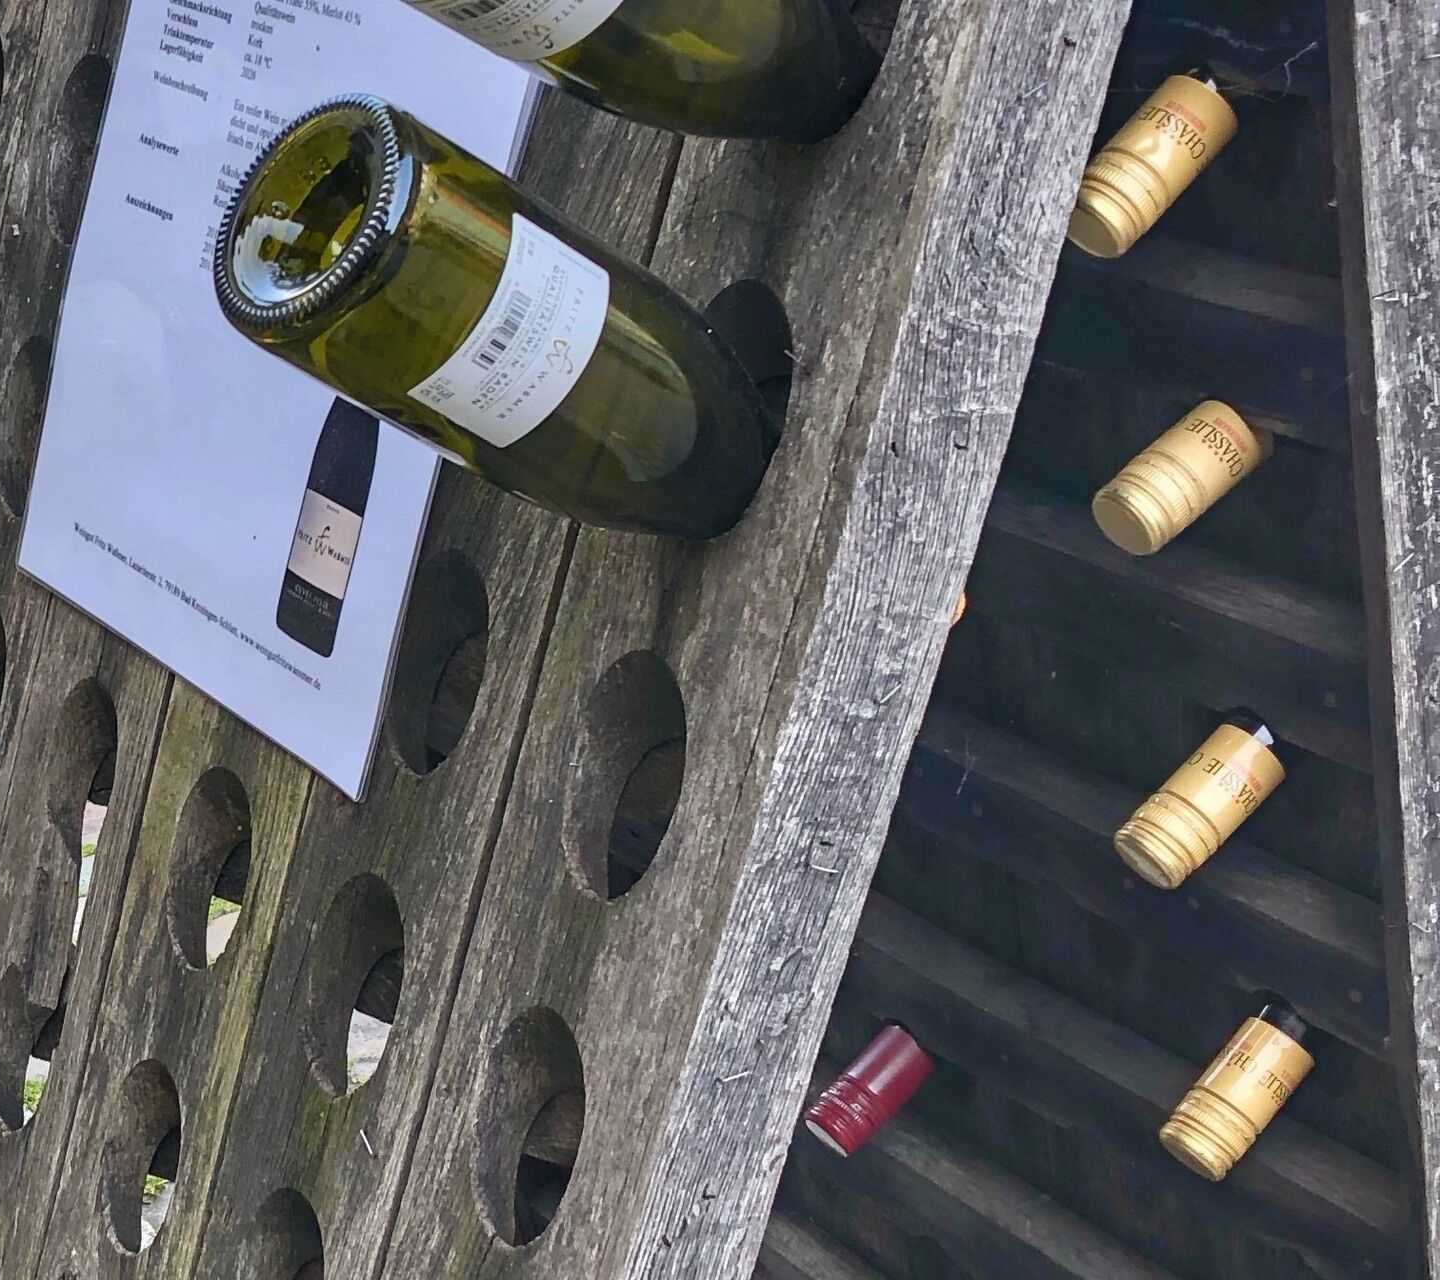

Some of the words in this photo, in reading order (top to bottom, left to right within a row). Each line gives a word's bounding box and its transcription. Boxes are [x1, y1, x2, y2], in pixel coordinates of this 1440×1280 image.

[163, 23, 215, 49] Trinktemperatur
[247, 33, 263, 49] Kork
[159, 39, 204, 64] Lagerfähigkeit
[153, 70, 209, 101] Weinbeschreibung
[233, 98, 245, 113] Ein
[138, 133, 179, 157] Analysewerte
[124, 193, 174, 221] Auszeichnungen
[1184, 418, 1244, 477] CHASSLIE
